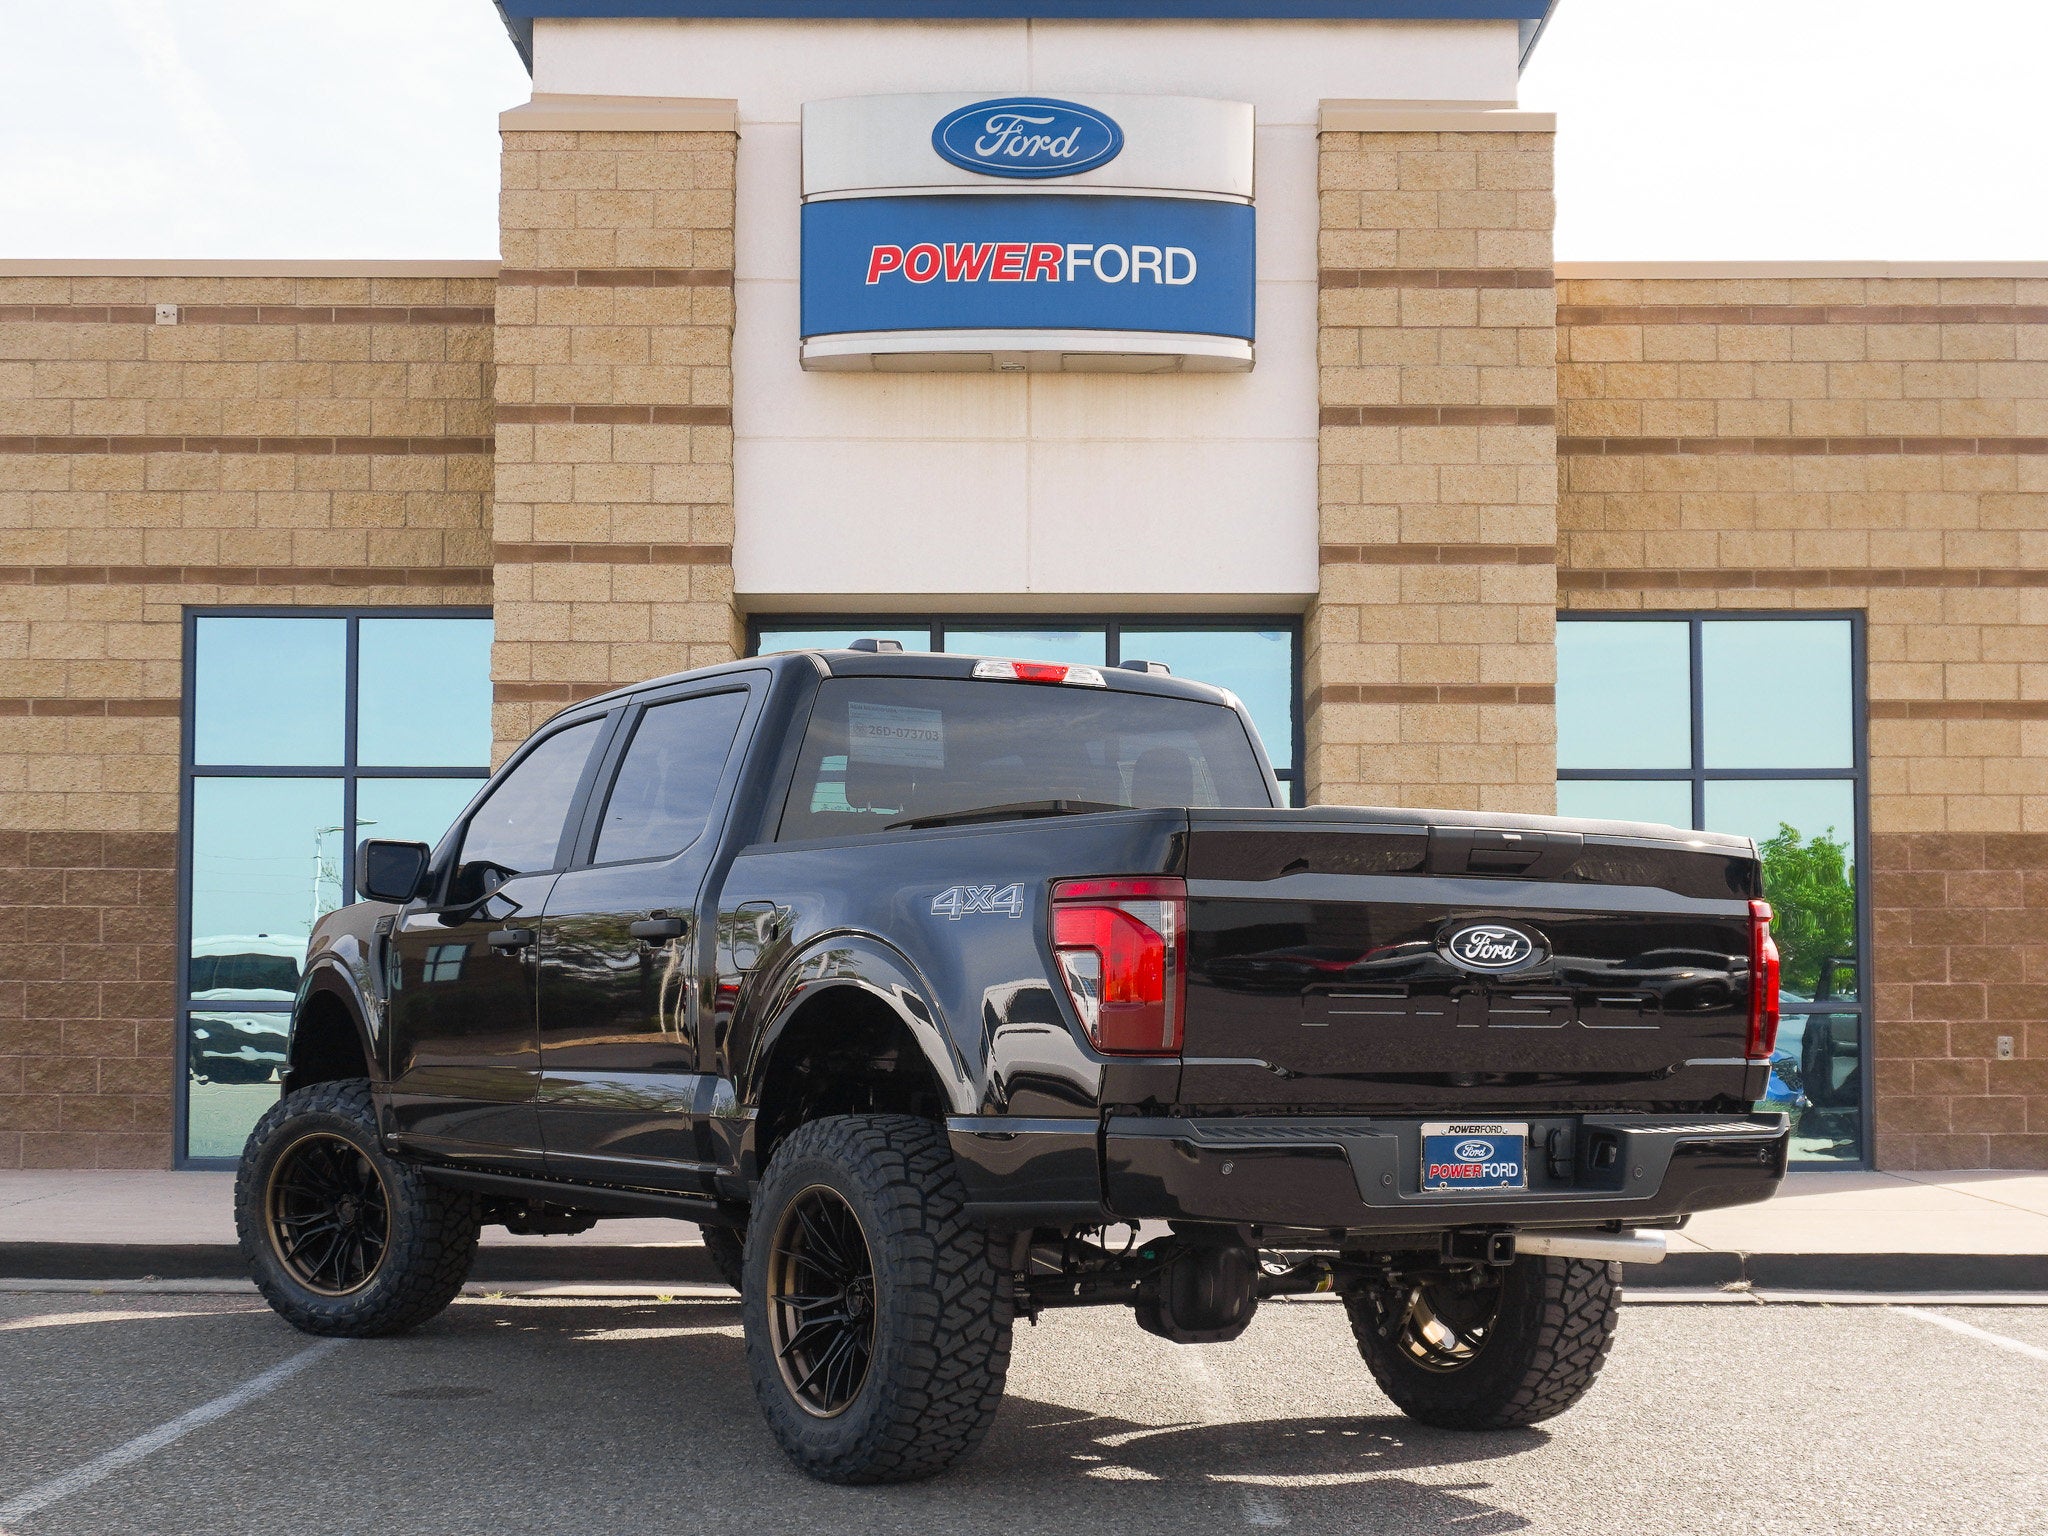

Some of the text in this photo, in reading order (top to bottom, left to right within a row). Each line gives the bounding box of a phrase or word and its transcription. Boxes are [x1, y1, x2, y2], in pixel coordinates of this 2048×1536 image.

[974, 113, 1082, 158] Ford
[865, 241, 1198, 286] POWERFORD
[868, 724, 940, 741] 26D-073703
[1464, 931, 1519, 960] Ford
[1447, 1124, 1503, 1135] POWERFORD
[1461, 1143, 1488, 1157] Ford
[1428, 1162, 1519, 1180] POWERFORD
